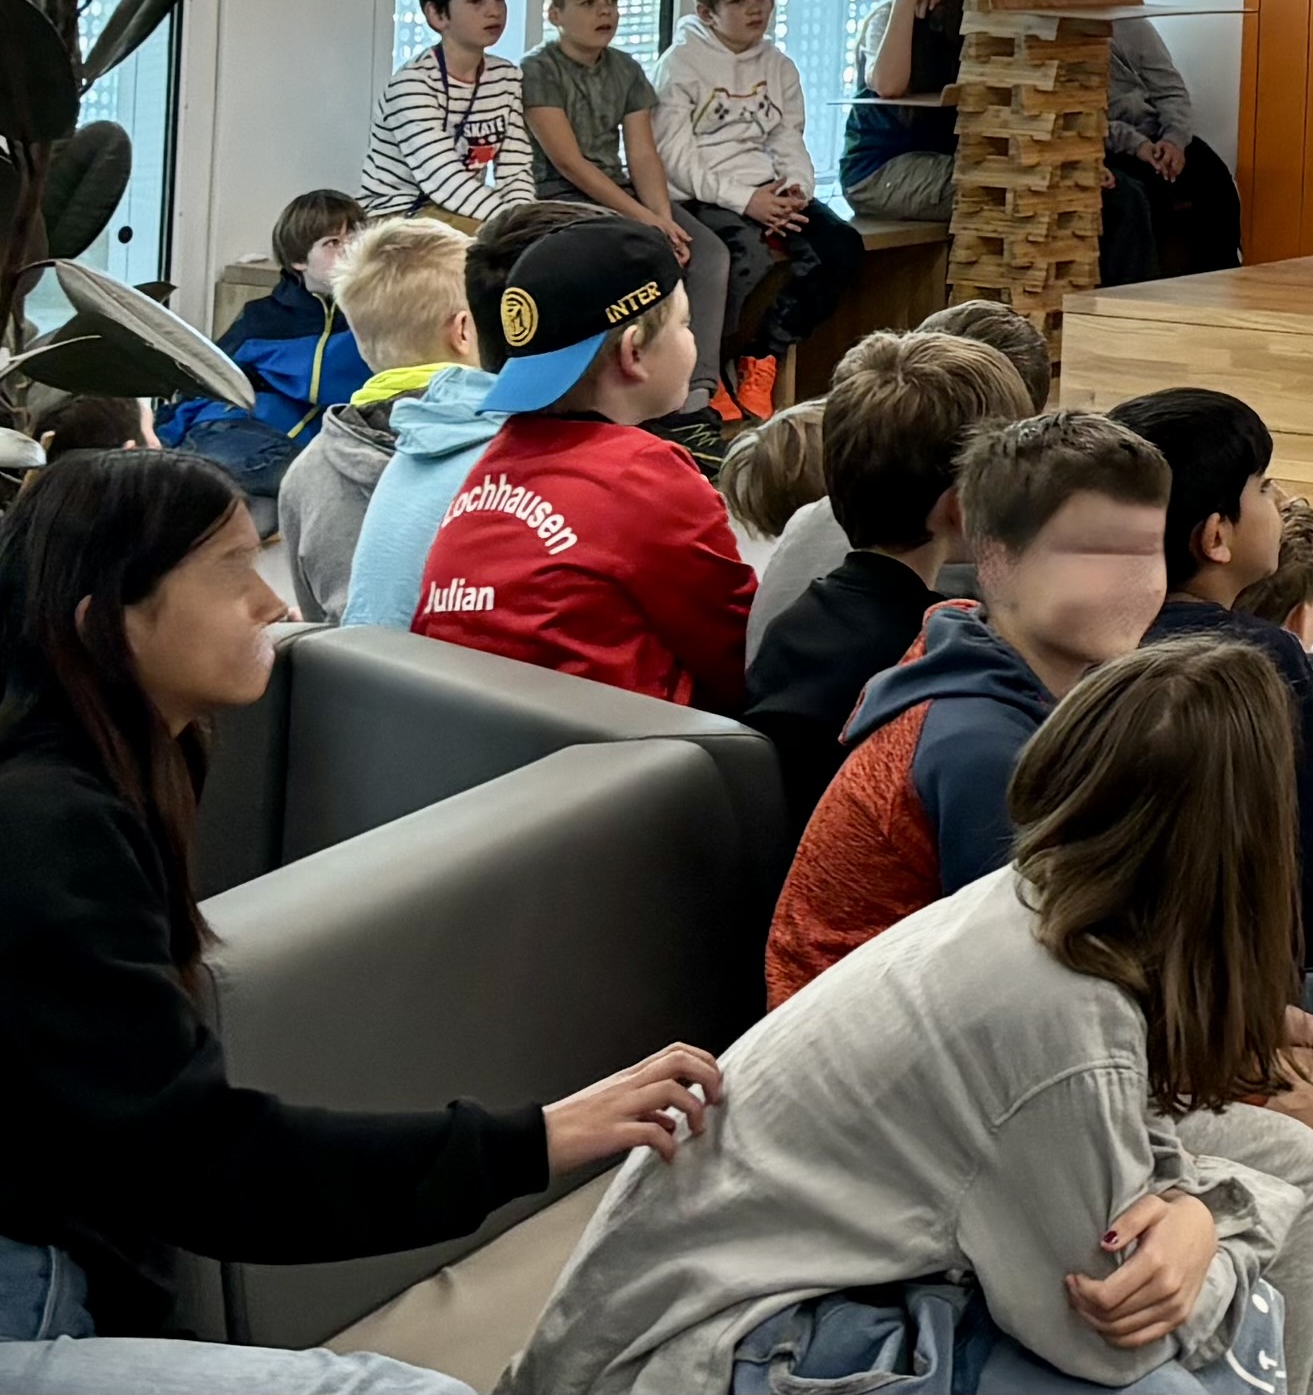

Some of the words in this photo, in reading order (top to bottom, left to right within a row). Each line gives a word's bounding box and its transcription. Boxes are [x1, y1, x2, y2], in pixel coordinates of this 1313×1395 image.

[463, 117, 505, 137] SKATE
[605, 281, 661, 323] INTER
[441, 474, 577, 555] Lochhausen
[424, 578, 495, 614] Julian
